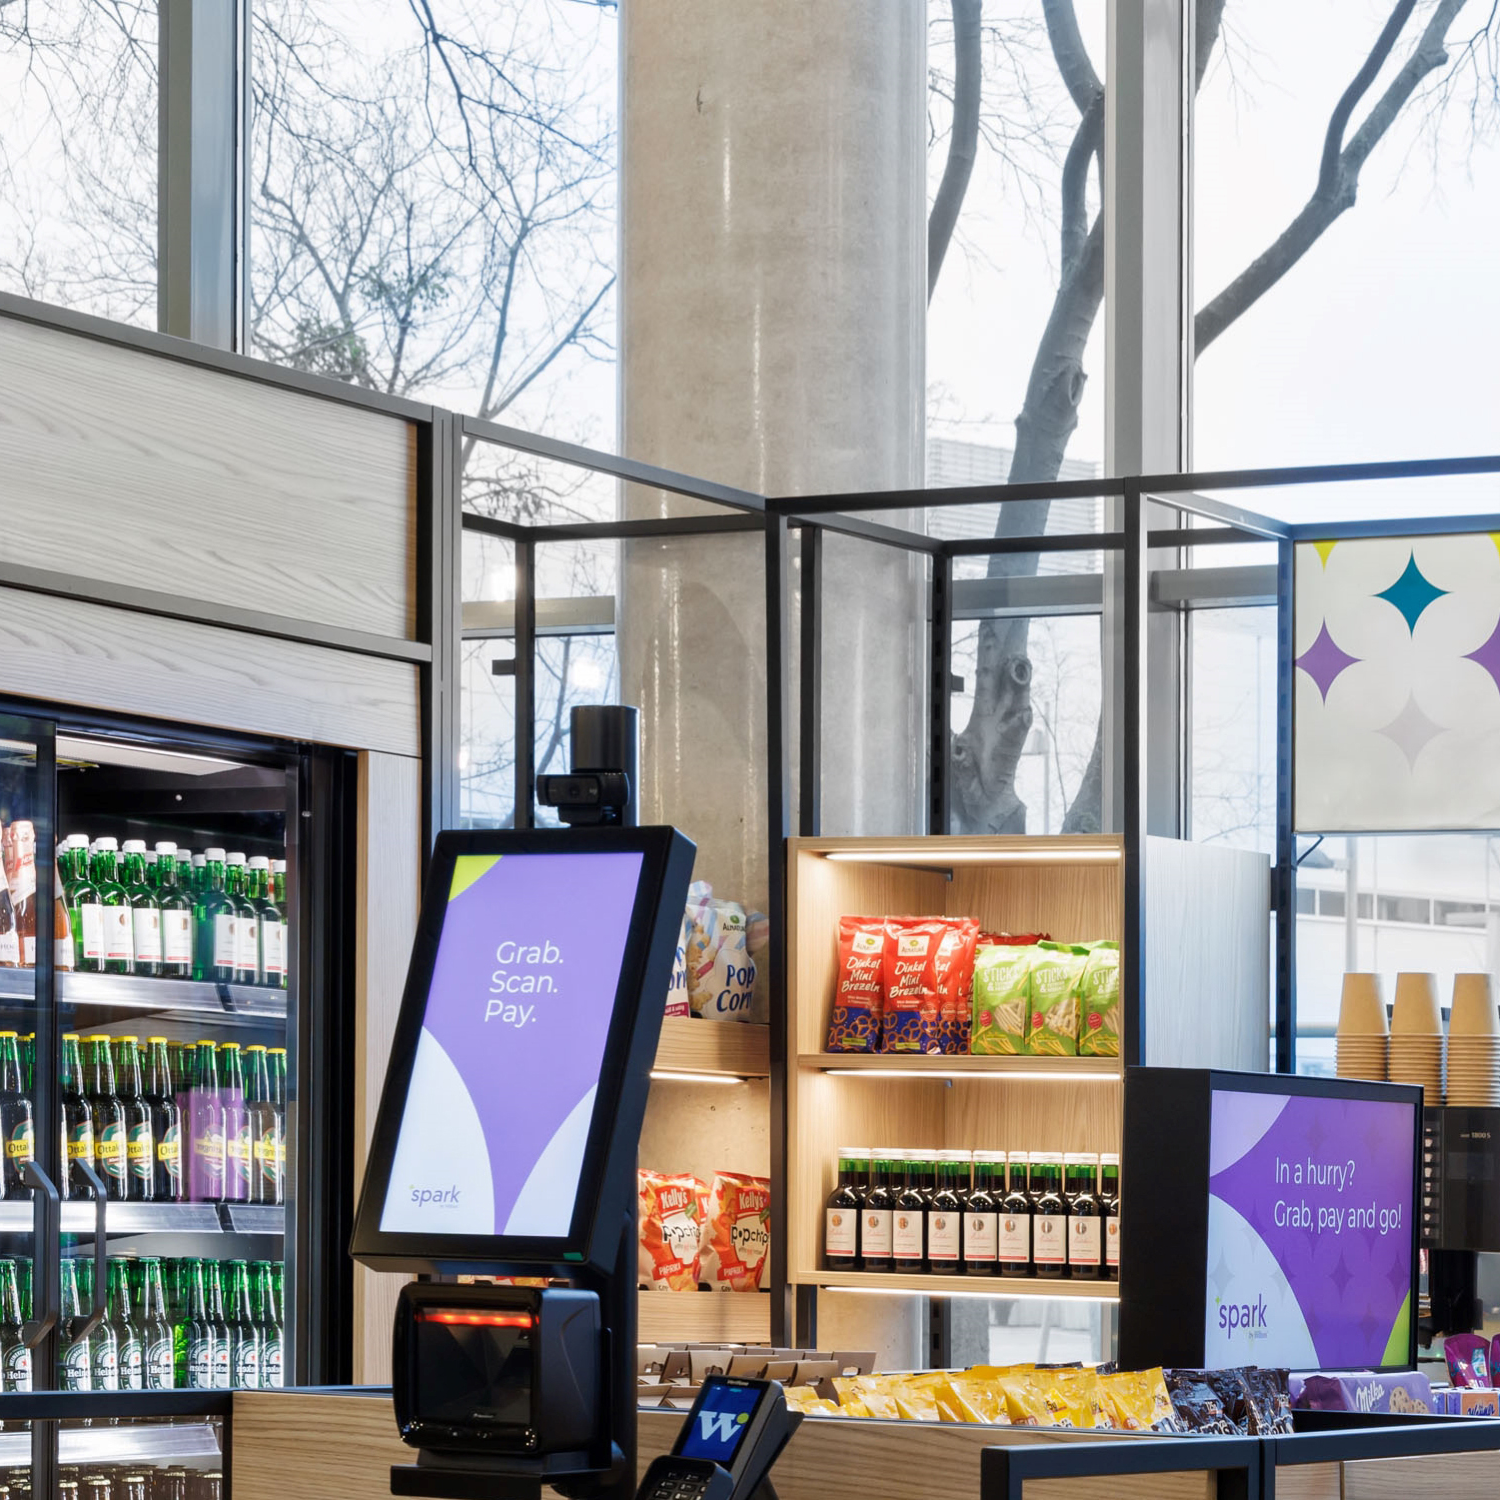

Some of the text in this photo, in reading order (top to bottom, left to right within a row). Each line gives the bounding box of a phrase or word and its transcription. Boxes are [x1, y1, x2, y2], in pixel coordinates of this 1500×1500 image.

[495, 941, 564, 965] Grab.
[846, 956, 881, 970] Dinkel
[725, 964, 755, 989] Pop
[850, 970, 874, 982] Mini
[894, 961, 927, 975] Dinkel
[489, 970, 558, 994] Scan.
[841, 981, 881, 993] Brezeln
[900, 974, 921, 987] Mini
[484, 999, 538, 1028] Pay.
[1275, 1156, 1356, 1192] In a hurry?
[411, 1184, 462, 1208] spark
[660, 1187, 688, 1209] Kelly's
[738, 1189, 765, 1210] Kelly's
[1274, 1200, 1402, 1235] Grab, pay and go!
[1218, 1293, 1268, 1339] spark
[1356, 1382, 1386, 1411] Milka
[698, 1410, 742, 1443] W
